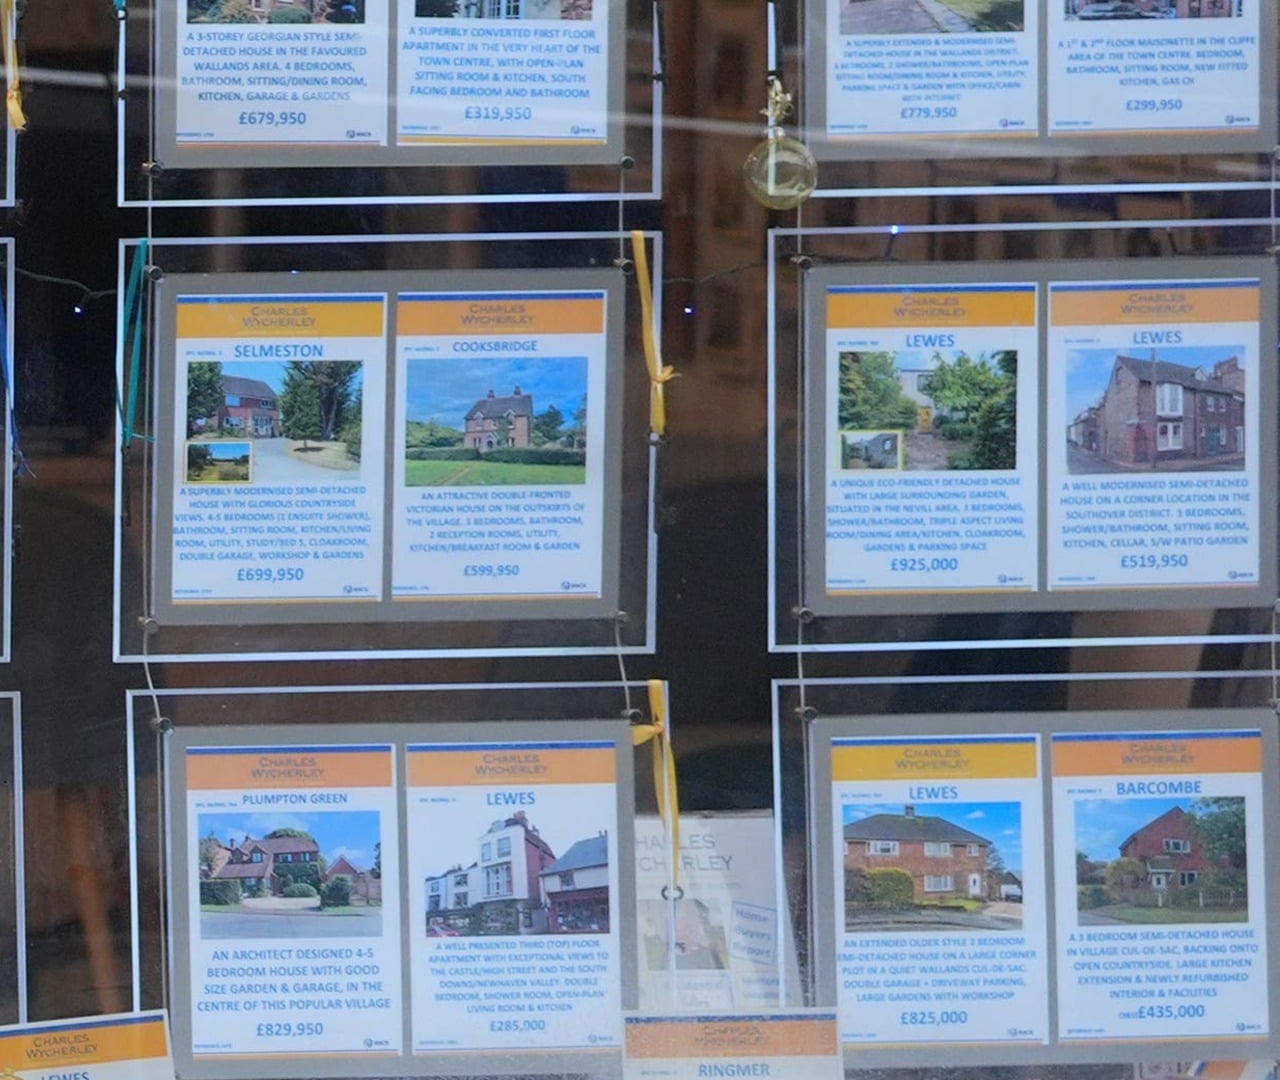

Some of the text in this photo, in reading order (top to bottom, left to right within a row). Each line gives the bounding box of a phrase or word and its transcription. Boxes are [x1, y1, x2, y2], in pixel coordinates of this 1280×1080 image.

[900, 107, 956, 118] £779,950
[1126, 99, 1183, 112] £299,950
[240, 112, 306, 126] £679,950
[464, 106, 532, 120] £319,950
[906, 334, 955, 348] LEWES
[1133, 330, 1182, 344] LEWES
[234, 344, 323, 358] SELMESTON
[452, 340, 538, 352] COOKSBRIDGE
[890, 558, 958, 572] £925,000
[1120, 554, 1188, 568] £519,950
[237, 568, 304, 582] £699,950
[464, 564, 520, 576] £599,950
[909, 786, 958, 800] LEWES
[1116, 780, 1202, 796] BARCOMBE
[242, 793, 348, 805] PLUMPTON GREEN
[487, 792, 535, 806] LEWES
[212, 948, 374, 960] AN ARCHITECT DESIGNED 4-5
[901, 1011, 968, 1026] £825,000
[256, 1022, 324, 1037] £829,950
[34, 1035, 90, 1048] CHARLES
[26, 1045, 98, 1060] WYCHERLEY
[699, 1063, 770, 1077] RINGMER
